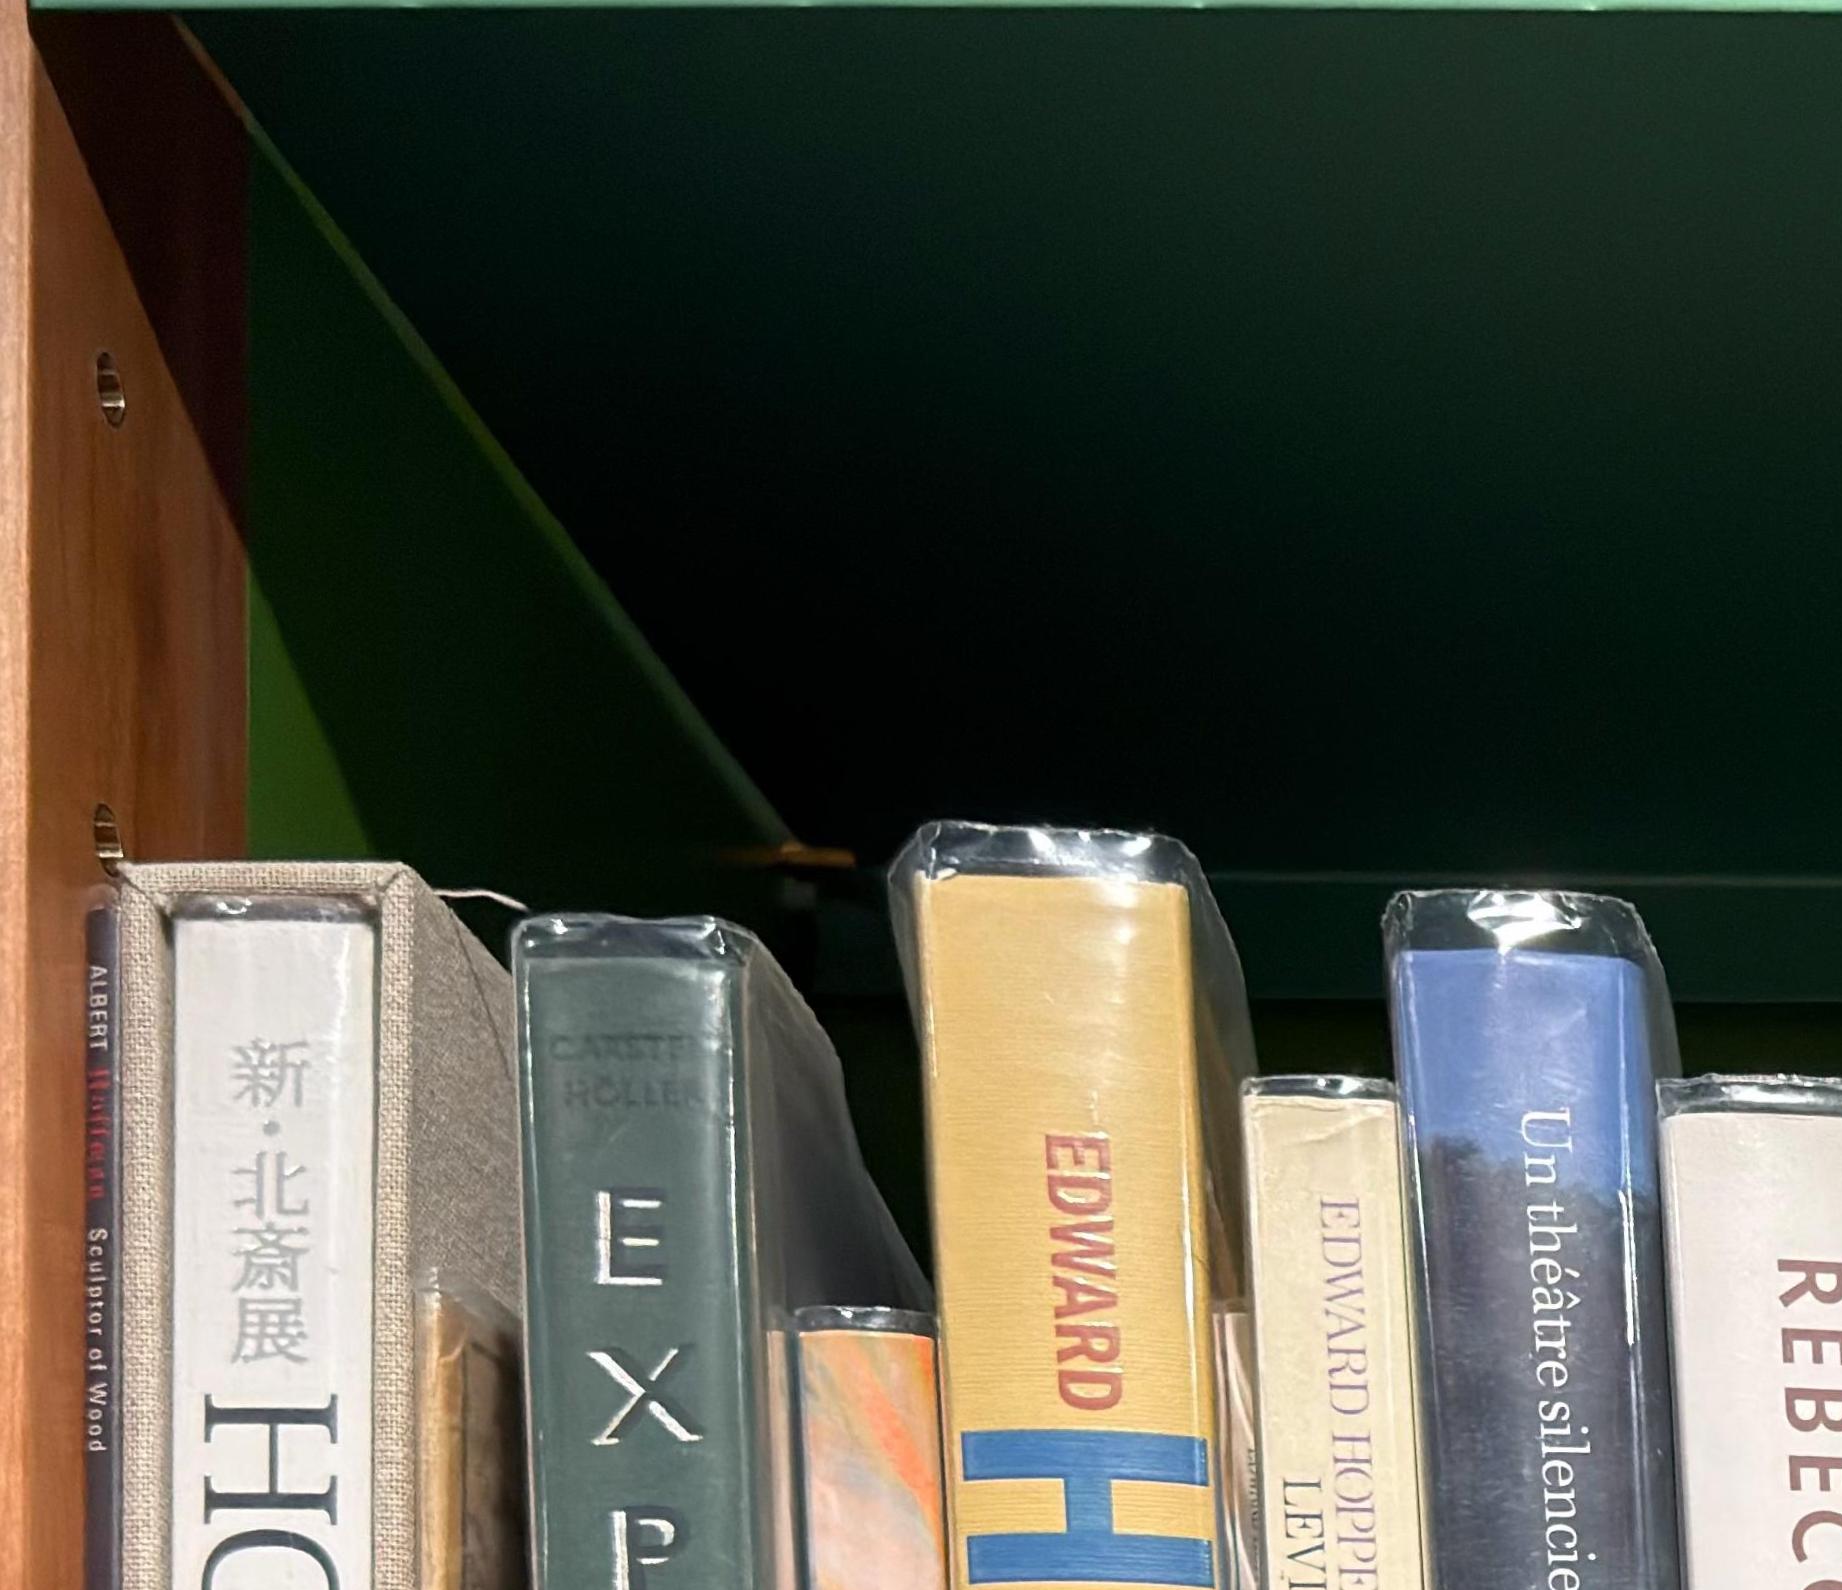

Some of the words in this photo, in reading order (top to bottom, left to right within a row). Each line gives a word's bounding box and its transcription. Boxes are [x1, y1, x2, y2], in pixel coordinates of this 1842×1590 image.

[88, 965, 108, 1051] ALBERT
[1520, 1108, 1572, 1185] Un
[88, 1228, 108, 1335] Sculptor
[1044, 1132, 1123, 1411] EDWARD
[1319, 1197, 1369, 1416] EDWARD
[1527, 1201, 1581, 1387] théâtre
[89, 1347, 107, 1374] of
[88, 1386, 108, 1452] Wood
